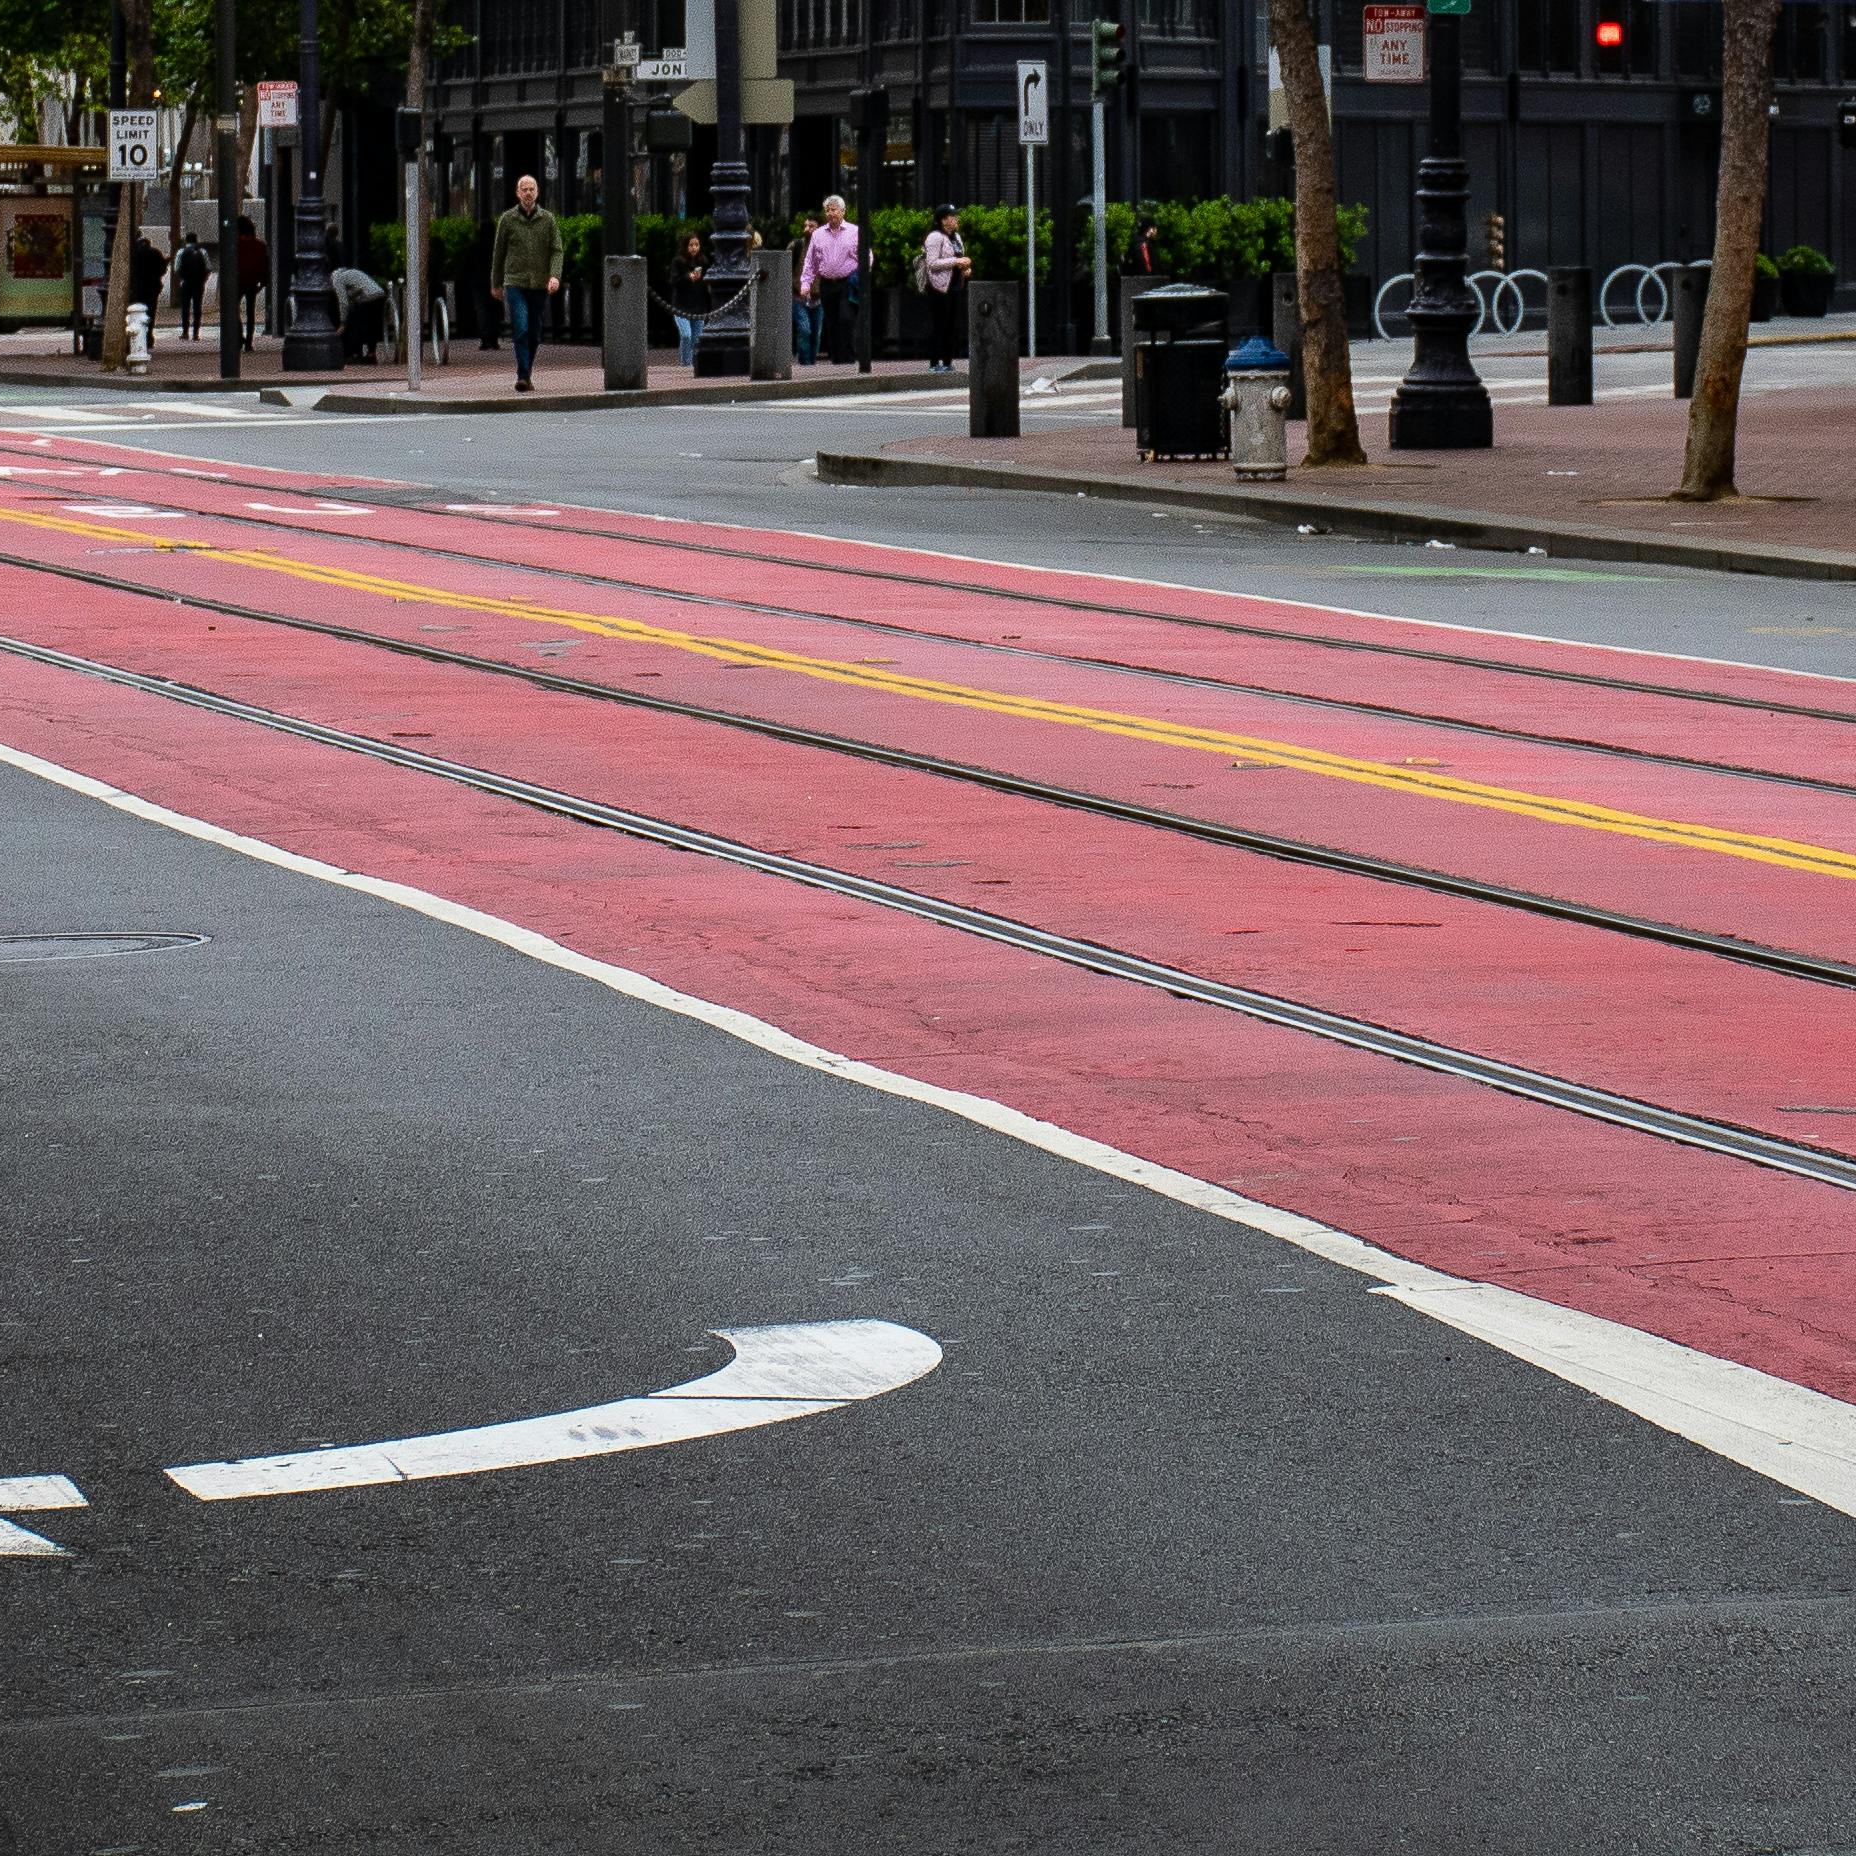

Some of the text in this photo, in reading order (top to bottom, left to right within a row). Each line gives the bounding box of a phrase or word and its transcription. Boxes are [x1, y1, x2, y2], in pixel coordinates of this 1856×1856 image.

[1374, 8, 1416, 17] TOW-AWAY
[1366, 19, 1425, 33] NO STOPPING
[1381, 40, 1408, 52] ANY
[1380, 53, 1409, 65] TIME
[651, 63, 687, 76] JON
[113, 115, 154, 126] SPEED
[116, 130, 150, 140] LIMIT
[118, 144, 148, 166] 10
